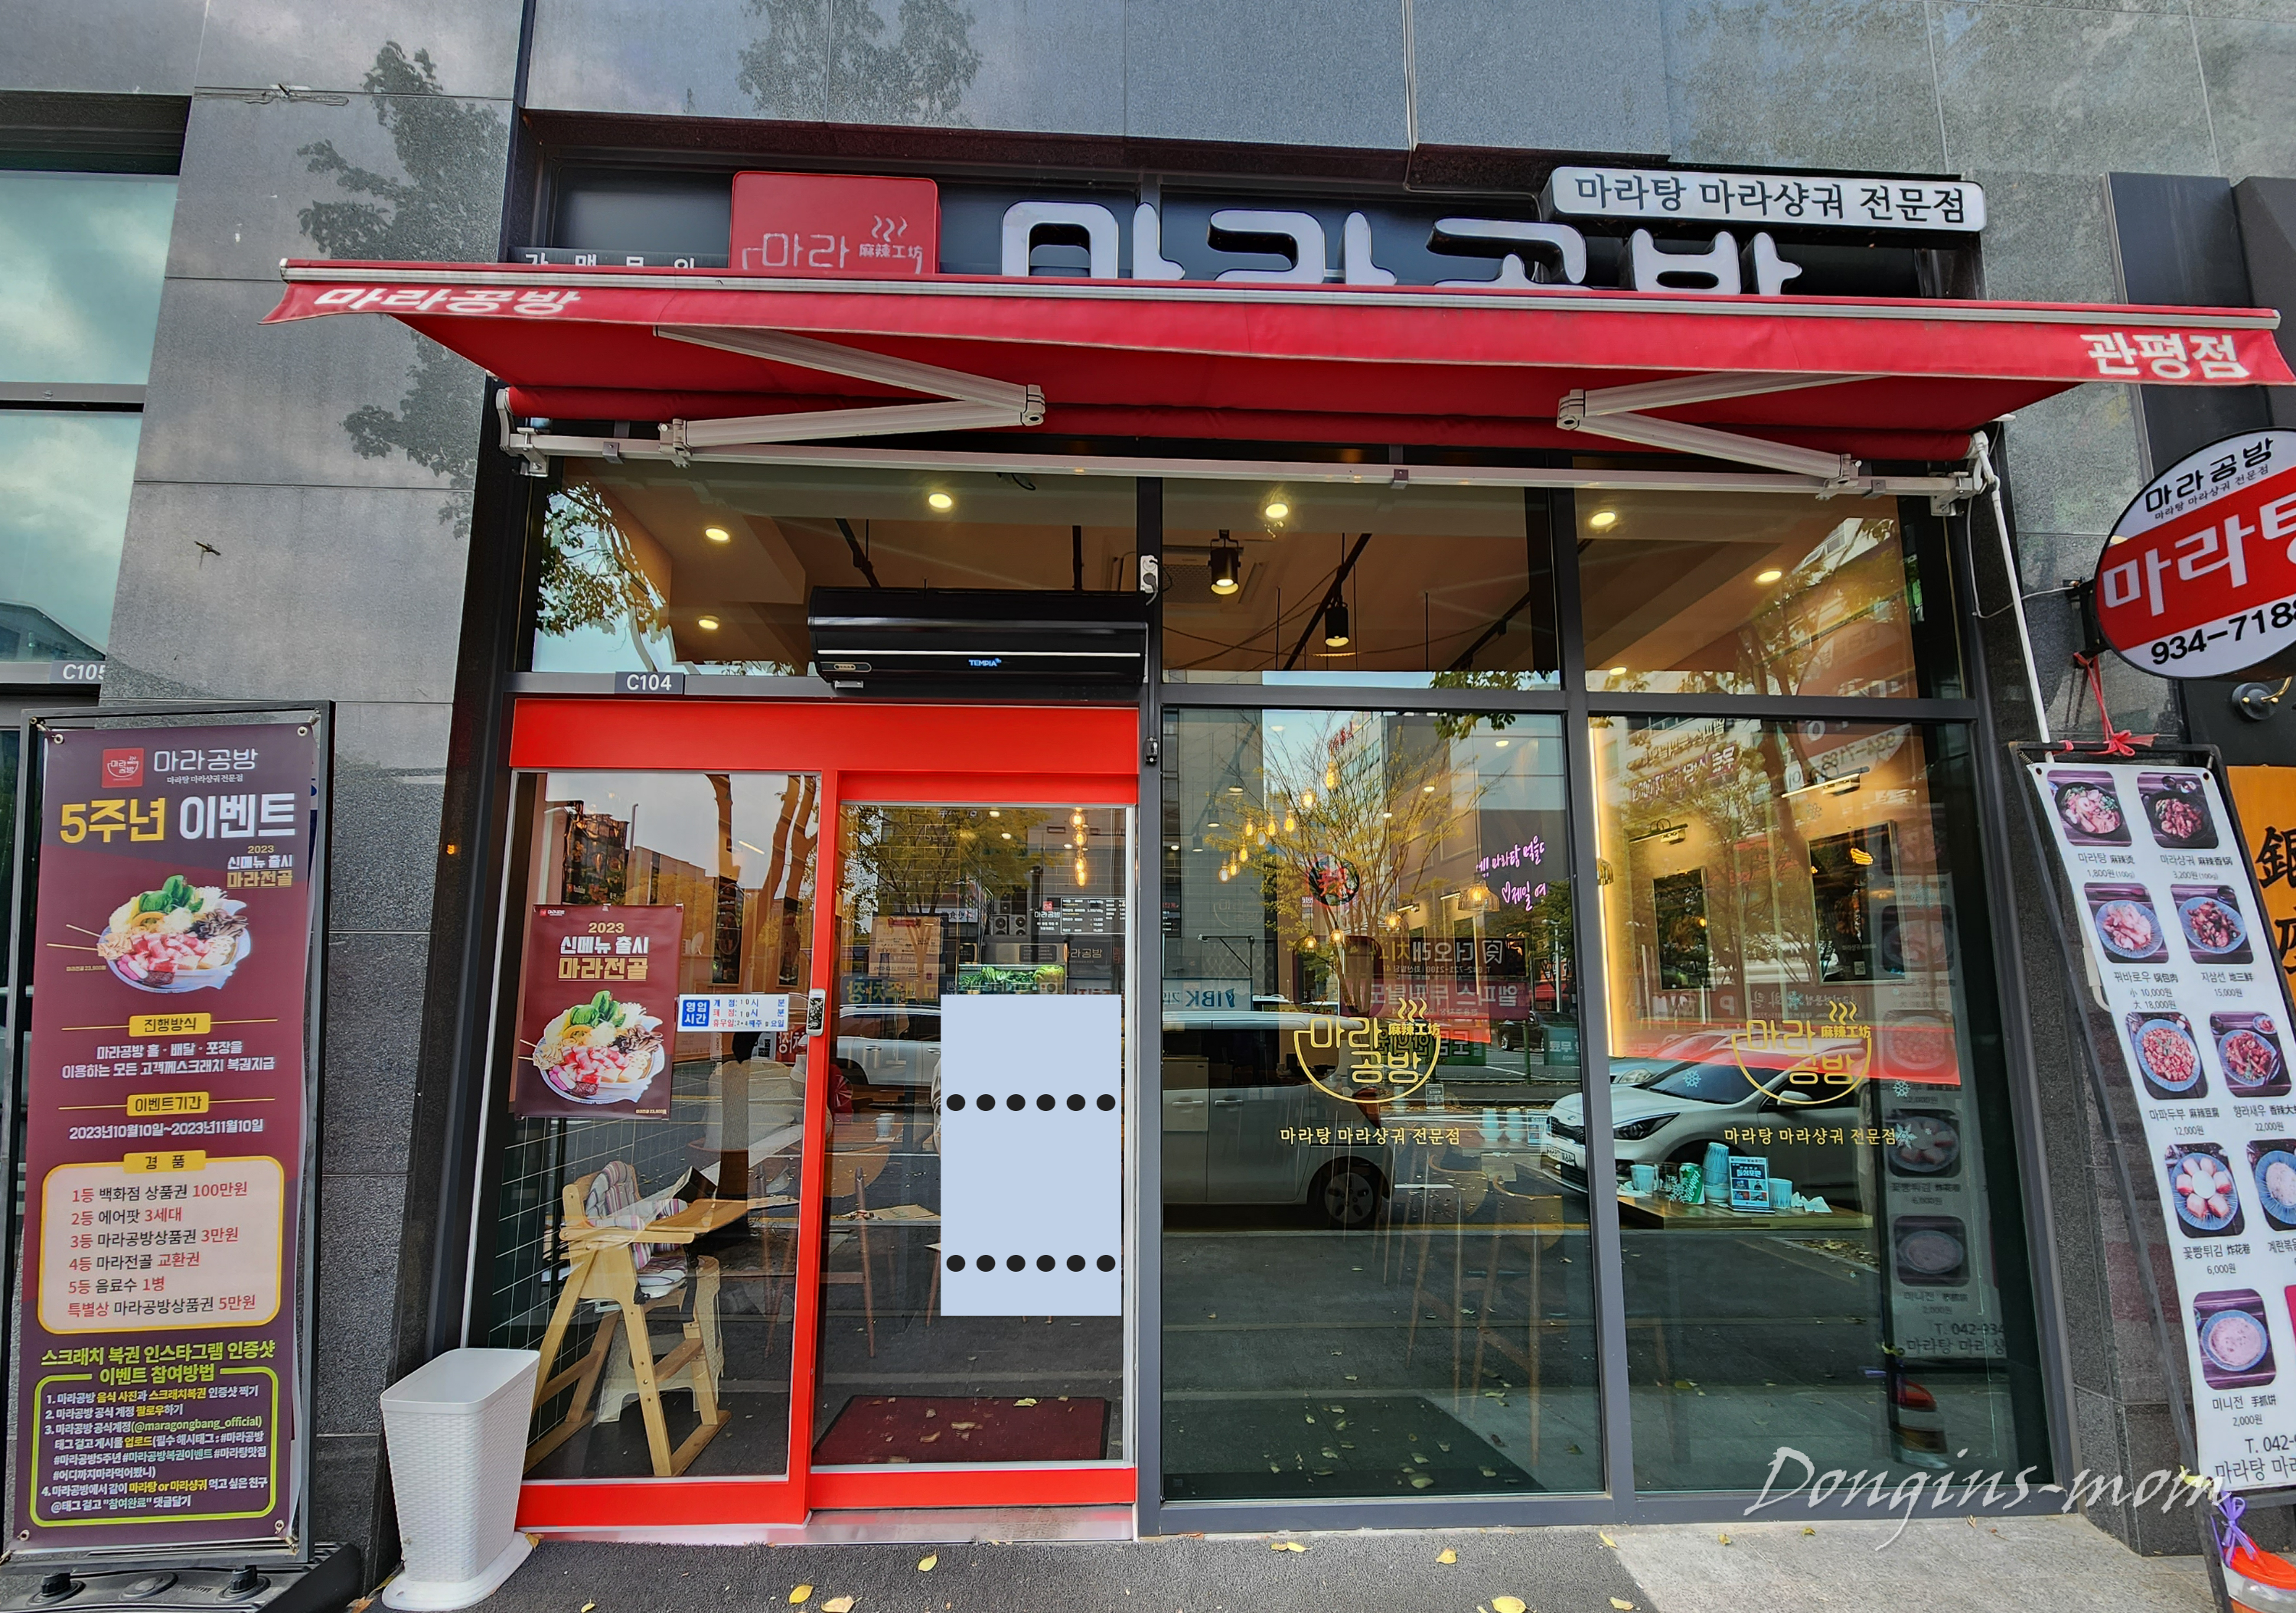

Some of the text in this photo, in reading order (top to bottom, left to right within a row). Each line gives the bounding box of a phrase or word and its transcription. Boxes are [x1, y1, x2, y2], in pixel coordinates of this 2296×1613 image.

[1575, 174, 1965, 223] 마라탕 마라샹궈 전문점
[315, 288, 581, 315] 마라공방
[2080, 332, 2250, 379] 관평점
[2145, 438, 2273, 512] 마라공방
[2154, 501, 2183, 520] 마라탕
[2235, 464, 2268, 486] 전문점
[2151, 600, 2296, 665] 934-718
[968, 659, 998, 667] TEMPIA
[627, 675, 672, 692] C104
[154, 748, 259, 772] 마라공방
[167, 776, 190, 785] 마라탕
[221, 774, 243, 782] 전문점
[60, 793, 295, 844] 5주년 이벤트
[247, 845, 275, 854] 2023
[2079, 852, 2107, 864] 마라탕
[227, 854, 293, 870] 신메뉴 출시
[227, 870, 294, 888] 마라전골
[588, 922, 625, 934] 2023
[560, 935, 649, 954] 신메뉴 출시
[1068, 947, 1103, 958] 라공방
[558, 957, 648, 979] 마라전골
[2114, 971, 2151, 982] 꿔바로우
[2200, 972, 2226, 982] 지삼선
[2141, 988, 2174, 999] 10,000원
[2214, 988, 2243, 999] 15,000원
[686, 1001, 707, 1013] 영업
[2144, 1000, 2177, 1010] 18,000원
[144, 1017, 197, 1032] 진행방식
[683, 1013, 707, 1025] 시간
[1310, 1017, 1383, 1049] 마라
[1746, 1019, 1816, 1050] 마라
[96, 1041, 243, 1060] 마라공방 홀 배달 포장을
[62, 1064, 111, 1079] 이용하는
[113, 1062, 138, 1077] 모든
[227, 1057, 276, 1072] 복권지급
[1350, 1051, 1422, 1083] 공방
[1787, 1053, 1856, 1085] 공방
[135, 1095, 201, 1113] 이벤트기간
[2233, 1106, 2265, 1118] 향라새우
[2150, 1109, 2187, 1122] 마파두부
[1280, 1126, 1461, 1145] 마라탕 마라샹궈 전문점
[1724, 1127, 1896, 1145] 마라탕 마라샹궈 전문점
[2174, 1126, 2204, 1136] 12,000원
[2255, 1123, 2285, 1132] 22,000원
[72, 1181, 247, 1203] 1등 백화점 상품권 100만원
[71, 1207, 183, 1226] 2등 에어팟 3세대
[70, 1227, 240, 1249] 3등 마라공방상품권 3만원
[2183, 1245, 2223, 1259] 꽃빵튀김
[69, 1251, 201, 1272] 4등 마라전골 교환권
[2207, 1263, 2236, 1275] 6,000원
[68, 1276, 166, 1294] 5등 음료수 1병
[67, 1295, 256, 1318] 특별상 마라공방상품권 5만원
[41, 1340, 276, 1366] 스크래치 복권 인스타그램 인증샷
[99, 1364, 215, 1386] 이벤트 참여방법
[47, 1385, 259, 1405] 1. 마라공방 음식 사진과 스크래치복권 인증샷 찍기
[2212, 1396, 2244, 1411] 미니전
[45, 1403, 184, 1419] 2. 마라공방 공식 계정 팔로우하기
[44, 1425, 54, 1435] 3.
[55, 1422, 93, 1435] 마라공방
[2232, 1414, 2263, 1427] 2,000원
[54, 1439, 74, 1451] 태그
[75, 1438, 94, 1450] 걸고
[95, 1436, 123, 1449] 게시물
[2245, 1435, 2296, 1454] T. 042-
[2214, 1457, 2265, 1484] 마라탕
[41, 1486, 51, 1497] 4.
[52, 1483, 108, 1497] 마라공방에서
[129, 1481, 158, 1494] 마라탕
[158, 1482, 170, 1491] or
[208, 1478, 228, 1489] 먹고
[228, 1477, 248, 1489] 싶은
[249, 1476, 268, 1489] 친구
[51, 1500, 81, 1514] @태그
[82, 1499, 102, 1511] 걸고
[153, 1494, 191, 1508] 댓글달기
